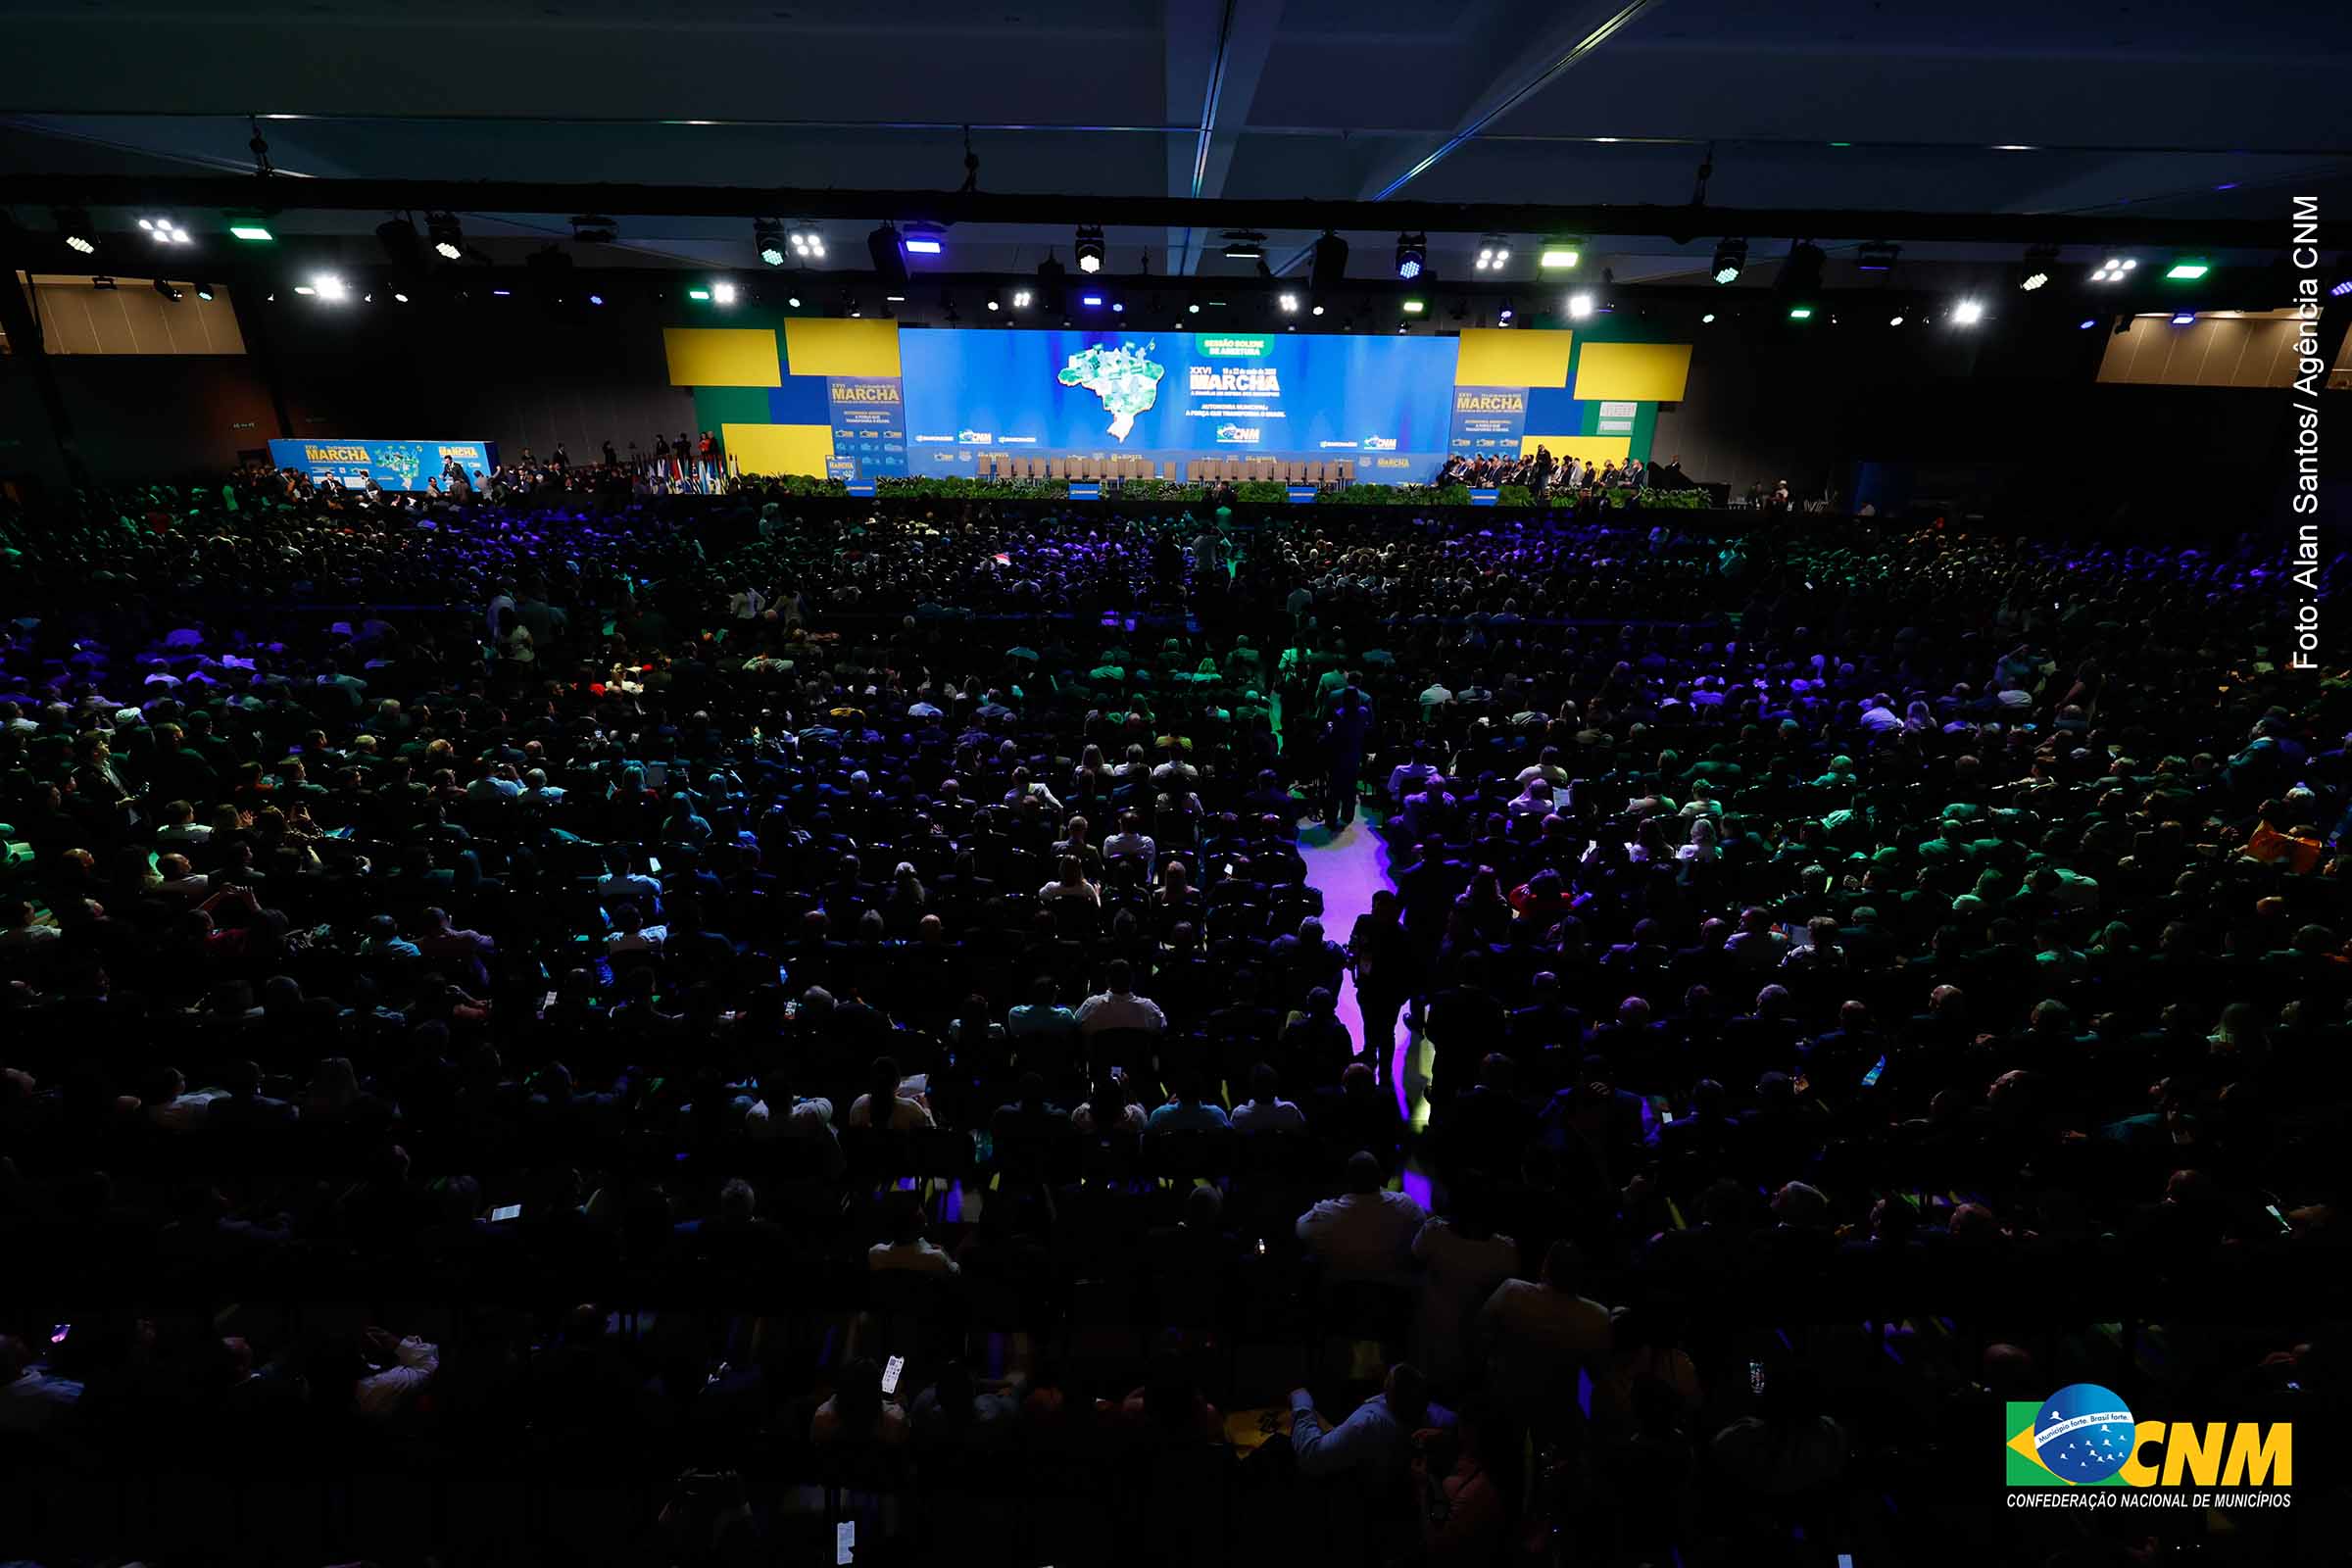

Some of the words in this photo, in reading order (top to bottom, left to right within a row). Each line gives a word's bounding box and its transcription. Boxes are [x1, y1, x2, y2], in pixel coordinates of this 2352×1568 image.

[1190, 374, 1280, 392] MARCHA
[832, 388, 900, 402] MARCHA
[1457, 397, 1524, 410] MARCHA
[1234, 428, 1260, 440] CNM
[306, 449, 370, 462] MARCHA
